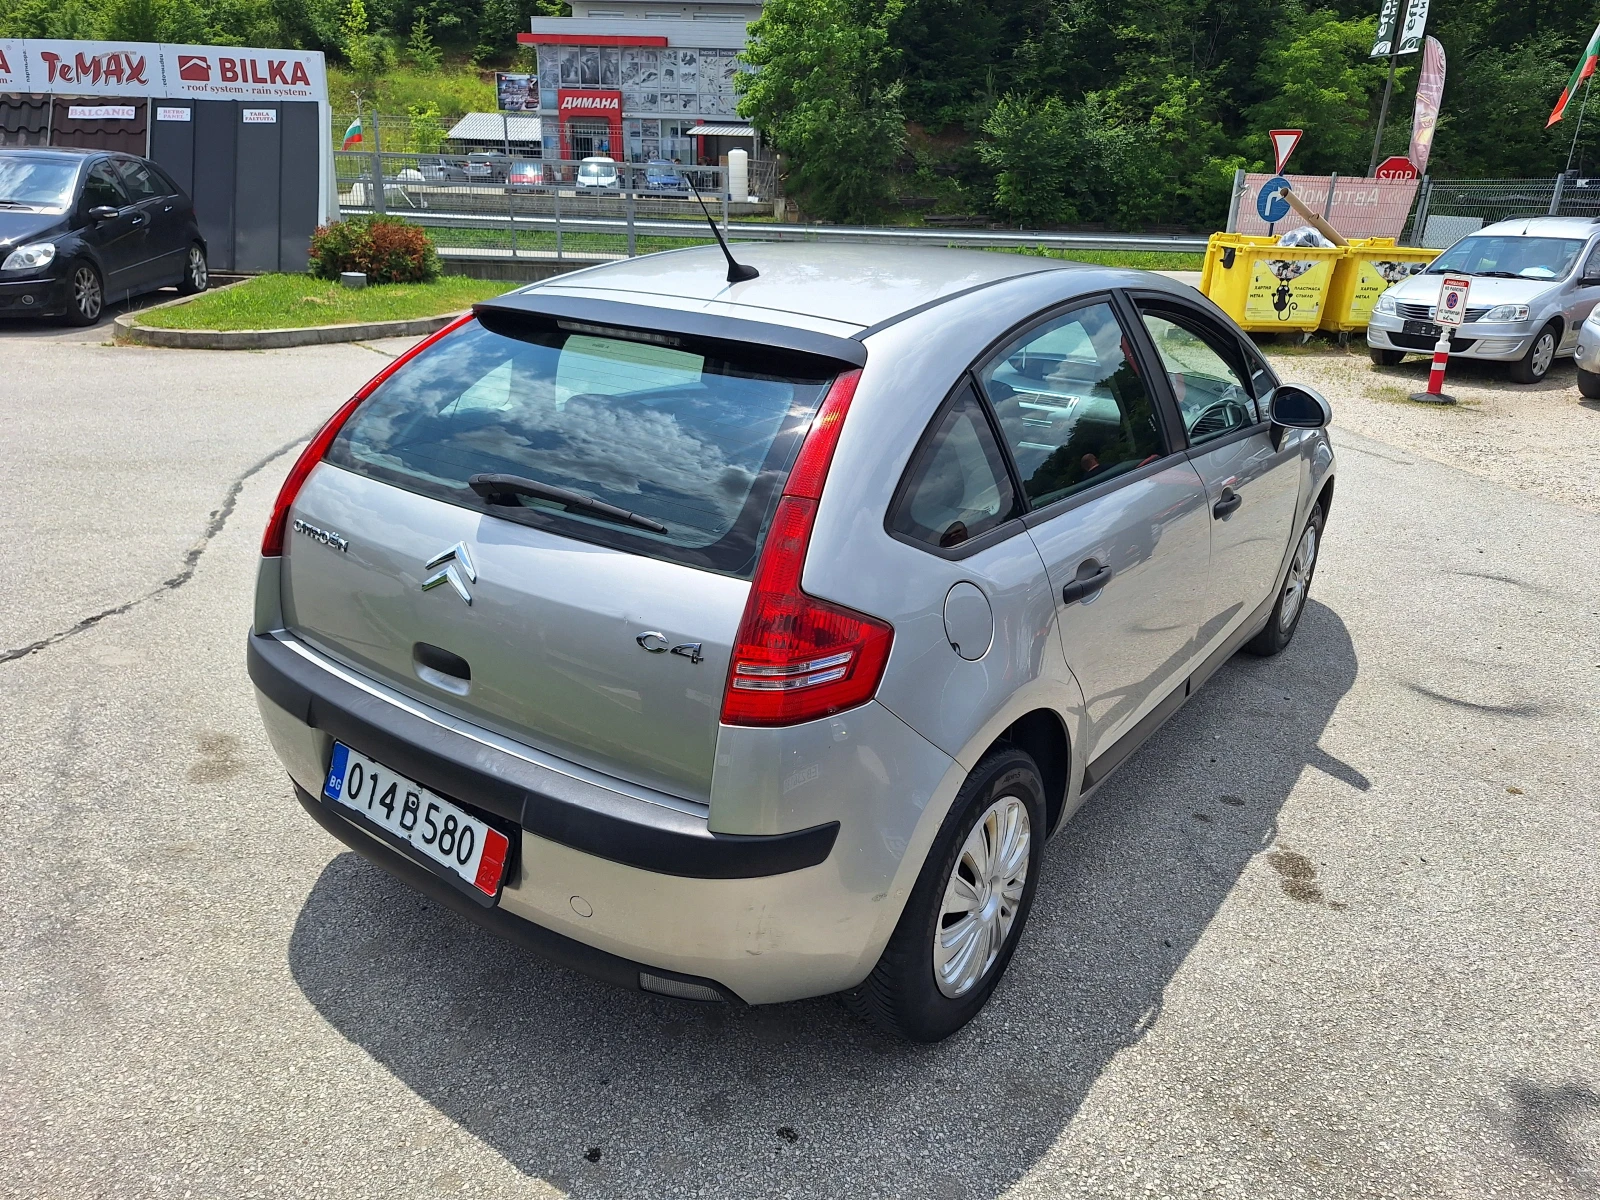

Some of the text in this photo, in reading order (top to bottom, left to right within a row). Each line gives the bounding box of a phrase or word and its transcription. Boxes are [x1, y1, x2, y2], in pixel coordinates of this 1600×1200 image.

[219, 58, 310, 86] BILKA
[187, 84, 307, 98] roof system rain system
[561, 97, 619, 109] ДИМАНА
[70, 108, 134, 117] BALCANIC
[1379, 169, 1413, 180] STOP
[293, 518, 349, 553] CITROËN
[636, 630, 704, 665] C4
[330, 775, 342, 791] BG
